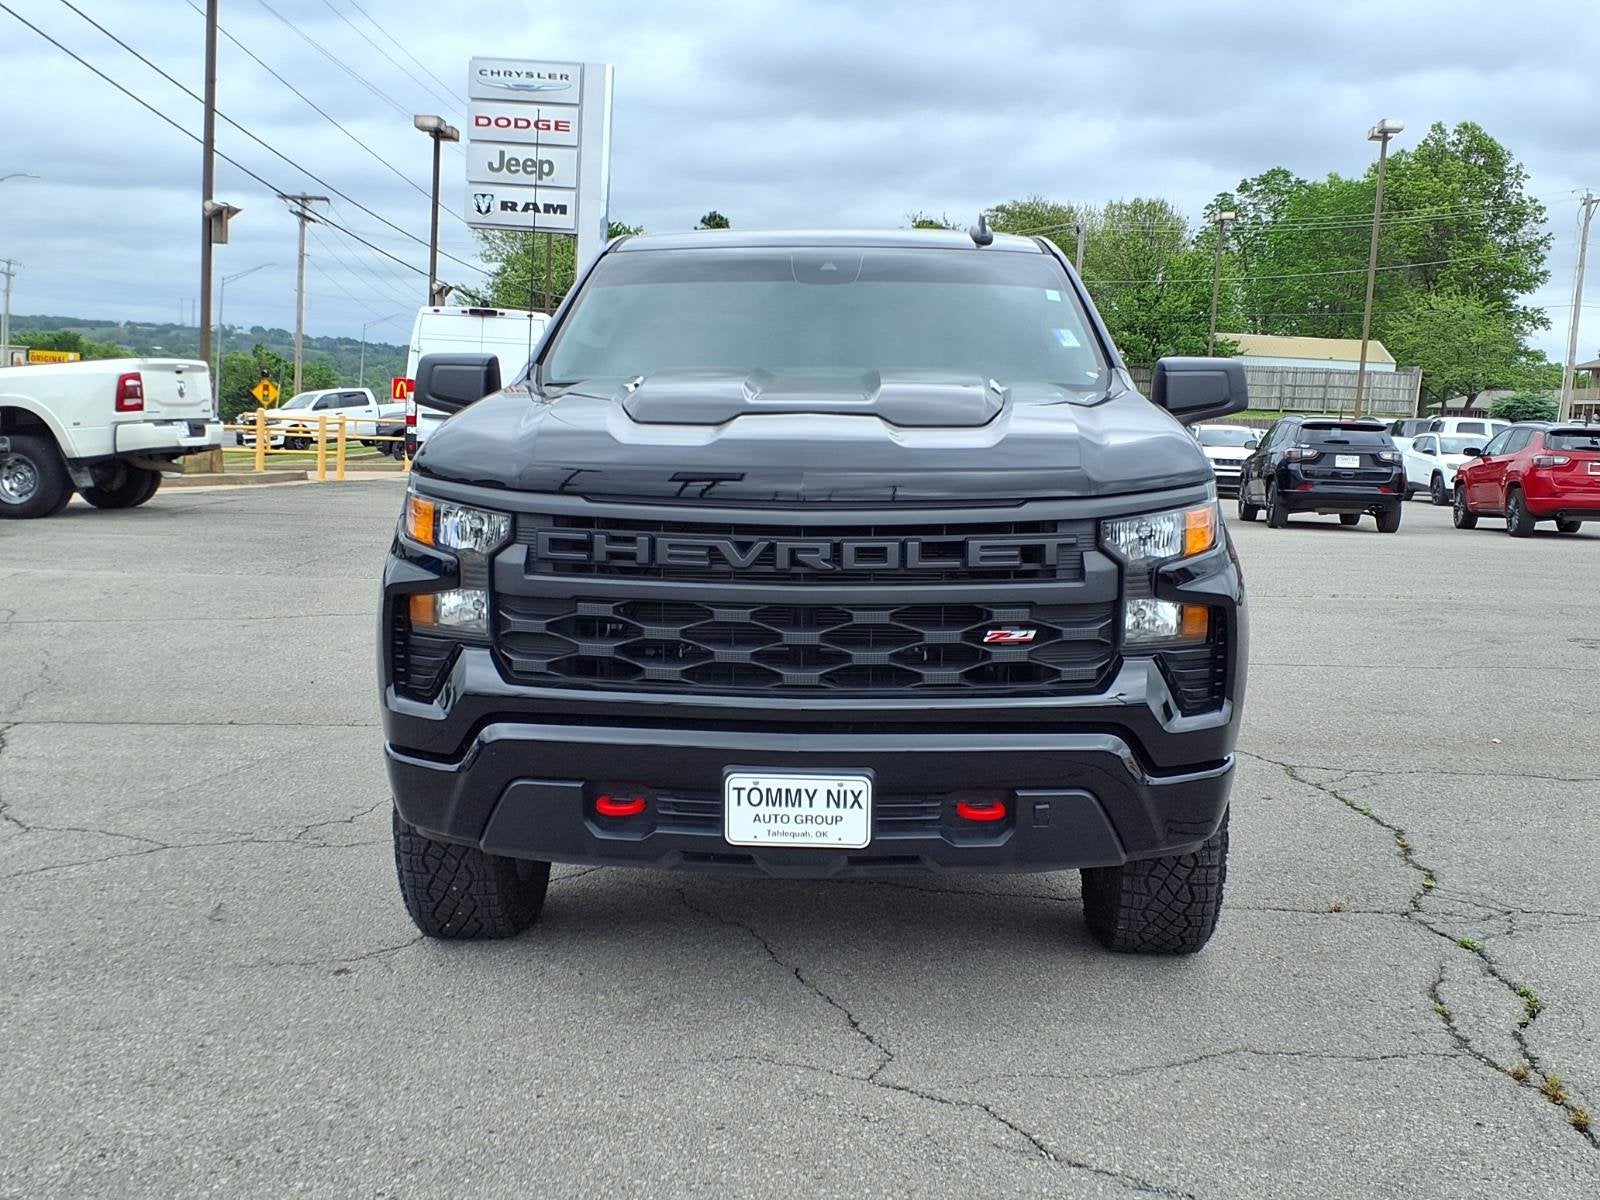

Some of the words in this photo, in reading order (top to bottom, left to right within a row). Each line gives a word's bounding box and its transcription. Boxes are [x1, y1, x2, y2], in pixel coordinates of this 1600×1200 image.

[478, 69, 570, 81] CHRYSLER
[474, 115, 571, 132] DODGE
[487, 150, 555, 181] Jeep
[500, 200, 568, 215] RAM
[536, 528, 1078, 570] CHEVROLET
[732, 786, 818, 809] TOMMY
[826, 788, 863, 810] NIX
[752, 813, 790, 825] AUTO
[794, 814, 843, 826] GROUP
[766, 829, 813, 839] Tahlequah,
[815, 830, 829, 839] OK
